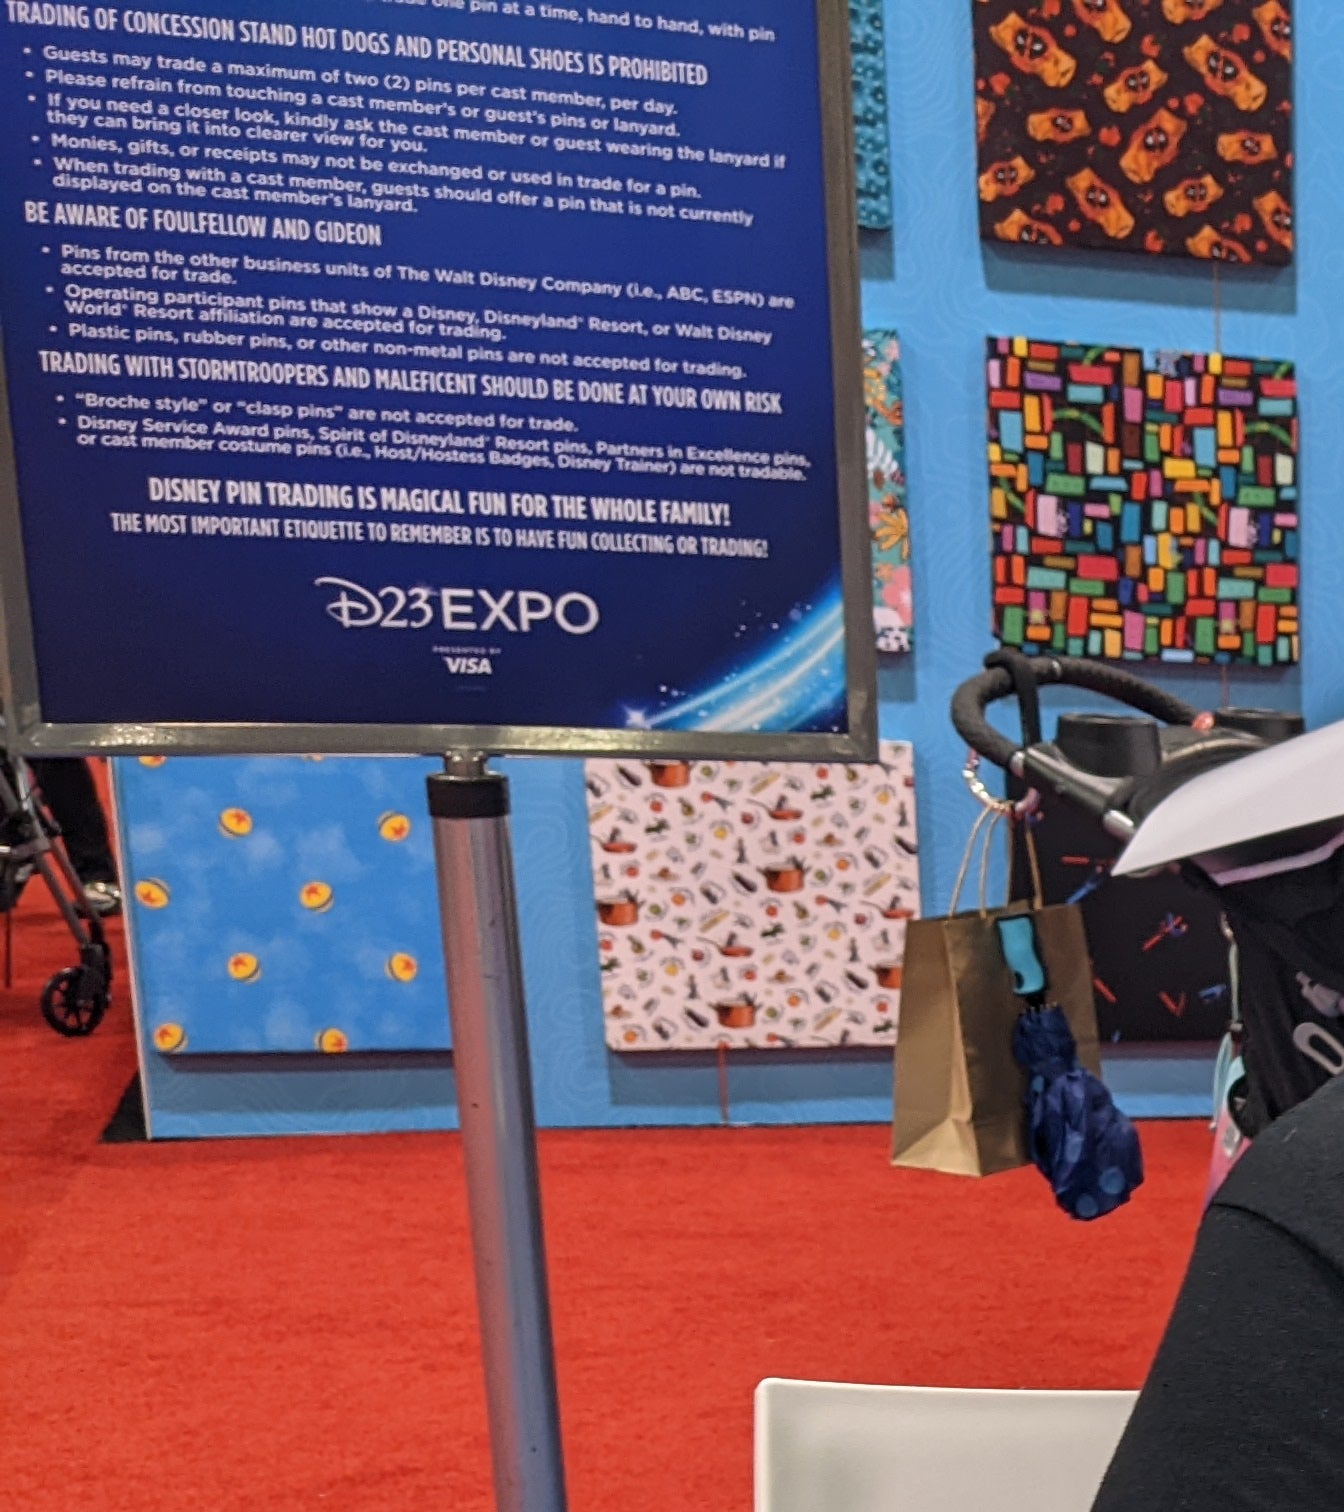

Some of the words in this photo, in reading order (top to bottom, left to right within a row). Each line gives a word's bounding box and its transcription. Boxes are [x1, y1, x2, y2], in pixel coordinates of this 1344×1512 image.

[5, 0, 90, 29] TRADING
[93, 7, 118, 30] OF
[122, 9, 235, 41] CONCESSION
[238, 20, 297, 46] STAND
[301, 26, 337, 50] HOT
[341, 29, 390, 55] DOGS
[394, 34, 432, 58] AND
[436, 38, 526, 68] PERSONAL
[528, 47, 584, 73] SHOES
[587, 52, 605, 76] IS
[607, 55, 708, 85] PROHIBITED
[42, 45, 108, 64] Guests
[112, 53, 152, 70] may
[156, 55, 207, 72] trade
[210, 61, 223, 74] a
[227, 63, 316, 81] maximum
[320, 69, 340, 83] of
[344, 71, 379, 87] two
[383, 74, 410, 91] (2)
[414, 78, 452, 93] pins
[456, 83, 486, 96] per
[490, 86, 527, 100] cast
[531, 90, 606, 109] member,
[609, 97, 639, 111] per
[642, 98, 677, 116] day.
[45, 68, 107, 87] Please
[111, 75, 173, 92] refrain
[176, 79, 222, 96] from
[225, 83, 307, 106] touching
[311, 93, 323, 105] a
[326, 94, 364, 109] cast
[460, 106, 480, 118] or
[550, 112, 586, 128] pins
[590, 117, 609, 130] or
[613, 117, 680, 136] lanyard.
[46, 109, 88, 128] they
[93, 115, 128, 128] can
[131, 115, 182, 135] bring
[186, 120, 200, 134] it
[204, 120, 241, 137] into
[245, 125, 308, 142] clearer
[312, 130, 354, 146] view
[358, 133, 385, 149] for
[390, 138, 427, 152] you.
[50, 132, 123, 153] Monies,
[127, 139, 175, 157] gifts,
[178, 145, 199, 157] or
[203, 147, 278, 164] receipts
[281, 153, 320, 169] may
[324, 155, 355, 169] not
[359, 156, 383, 172] be
[387, 160, 483, 180] exchanged
[487, 169, 507, 181] or
[510, 171, 552, 185] used
[556, 172, 573, 187] in
[576, 175, 622, 191] trade
[626, 178, 651, 193] for
[655, 183, 666, 195] a
[669, 183, 701, 198] pin.
[24, 200, 50, 223] BE
[53, 202, 122, 228] AWARE
[124, 206, 148, 230] OF
[152, 208, 267, 238] FOULFELLOW
[271, 217, 310, 241] AND
[313, 219, 382, 246] GIDEON
[68, 322, 130, 340] Plastic
[134, 326, 179, 344] pins,
[183, 330, 245, 346] rubber
[249, 333, 292, 350] pins,
[296, 338, 316, 350] or
[320, 338, 369, 353] other
[373, 342, 463, 359] non-metal
[466, 347, 504, 362] pins
[507, 351, 535, 364] are
[539, 352, 569, 366] not
[572, 355, 650, 371] accepted
[653, 358, 679, 372] for
[681, 360, 746, 379] trading.
[38, 349, 121, 376] TRADING
[123, 354, 174, 378] WITH
[177, 356, 329, 387] STORMTROOPERS
[332, 365, 371, 389] AND
[373, 368, 477, 395] MALEFICENT
[480, 374, 549, 399] SHOULD
[551, 378, 575, 401] BE
[577, 380, 625, 404] DONE
[627, 383, 648, 405] AT
[651, 385, 697, 408] YOUR
[700, 388, 741, 411] OWN
[743, 390, 782, 414] RISK
[148, 476, 221, 503] DISNEY
[225, 479, 262, 505] PIN
[264, 481, 354, 509] TRADING
[356, 485, 378, 510] IS
[379, 486, 465, 514] MAGICAL
[467, 490, 507, 516] FUN
[510, 492, 548, 518] FOR
[550, 494, 588, 520] THE
[589, 496, 657, 523] WHOLE
[659, 500, 731, 526] FAMILY!
[109, 512, 142, 533] THE
[144, 513, 187, 534] MOST
[190, 515, 280, 537] IMPORTANT
[283, 518, 364, 541] ETIQUETTE
[366, 522, 388, 542] TO
[389, 523, 472, 545] REMEMBER
[474, 526, 491, 546] IS
[492, 526, 513, 546] TO
[515, 528, 555, 549] HAVE
[557, 529, 588, 549] FUN
[590, 531, 674, 554] COLLECTING
[676, 535, 698, 554] OR
[700, 535, 768, 558] TRADING!
[440, 587, 600, 635] EXPO
[443, 656, 493, 676] VISA
